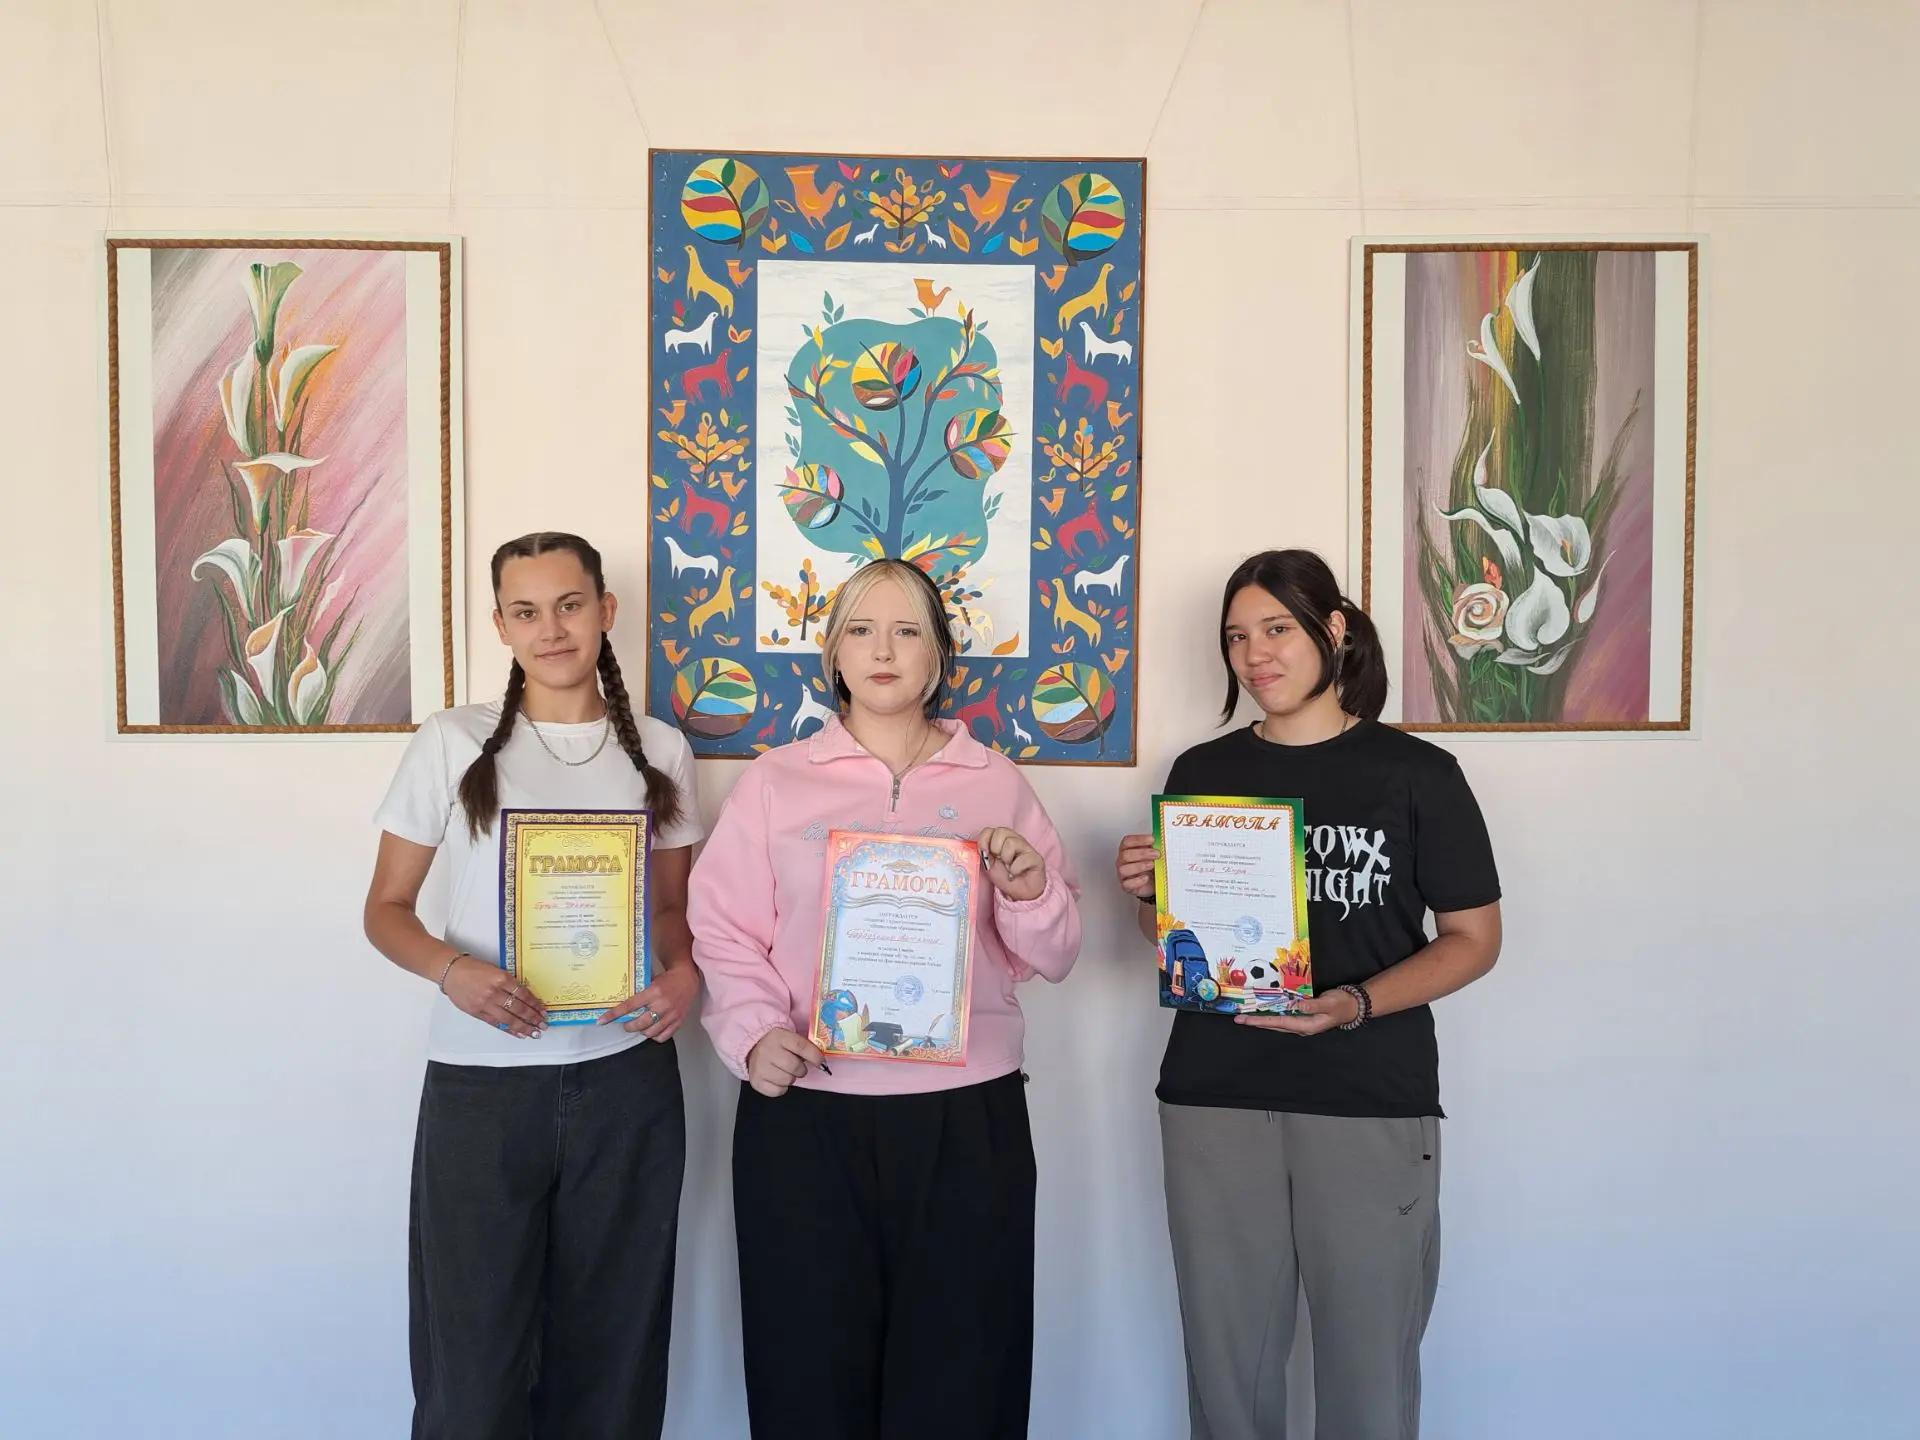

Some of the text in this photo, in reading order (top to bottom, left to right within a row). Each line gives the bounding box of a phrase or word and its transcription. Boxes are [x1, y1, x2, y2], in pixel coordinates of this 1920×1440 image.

[1172, 813, 1280, 831] ГРАМОТА
[529, 854, 623, 874] ГРАМОТА
[850, 871, 951, 895] ГРАМОТА
